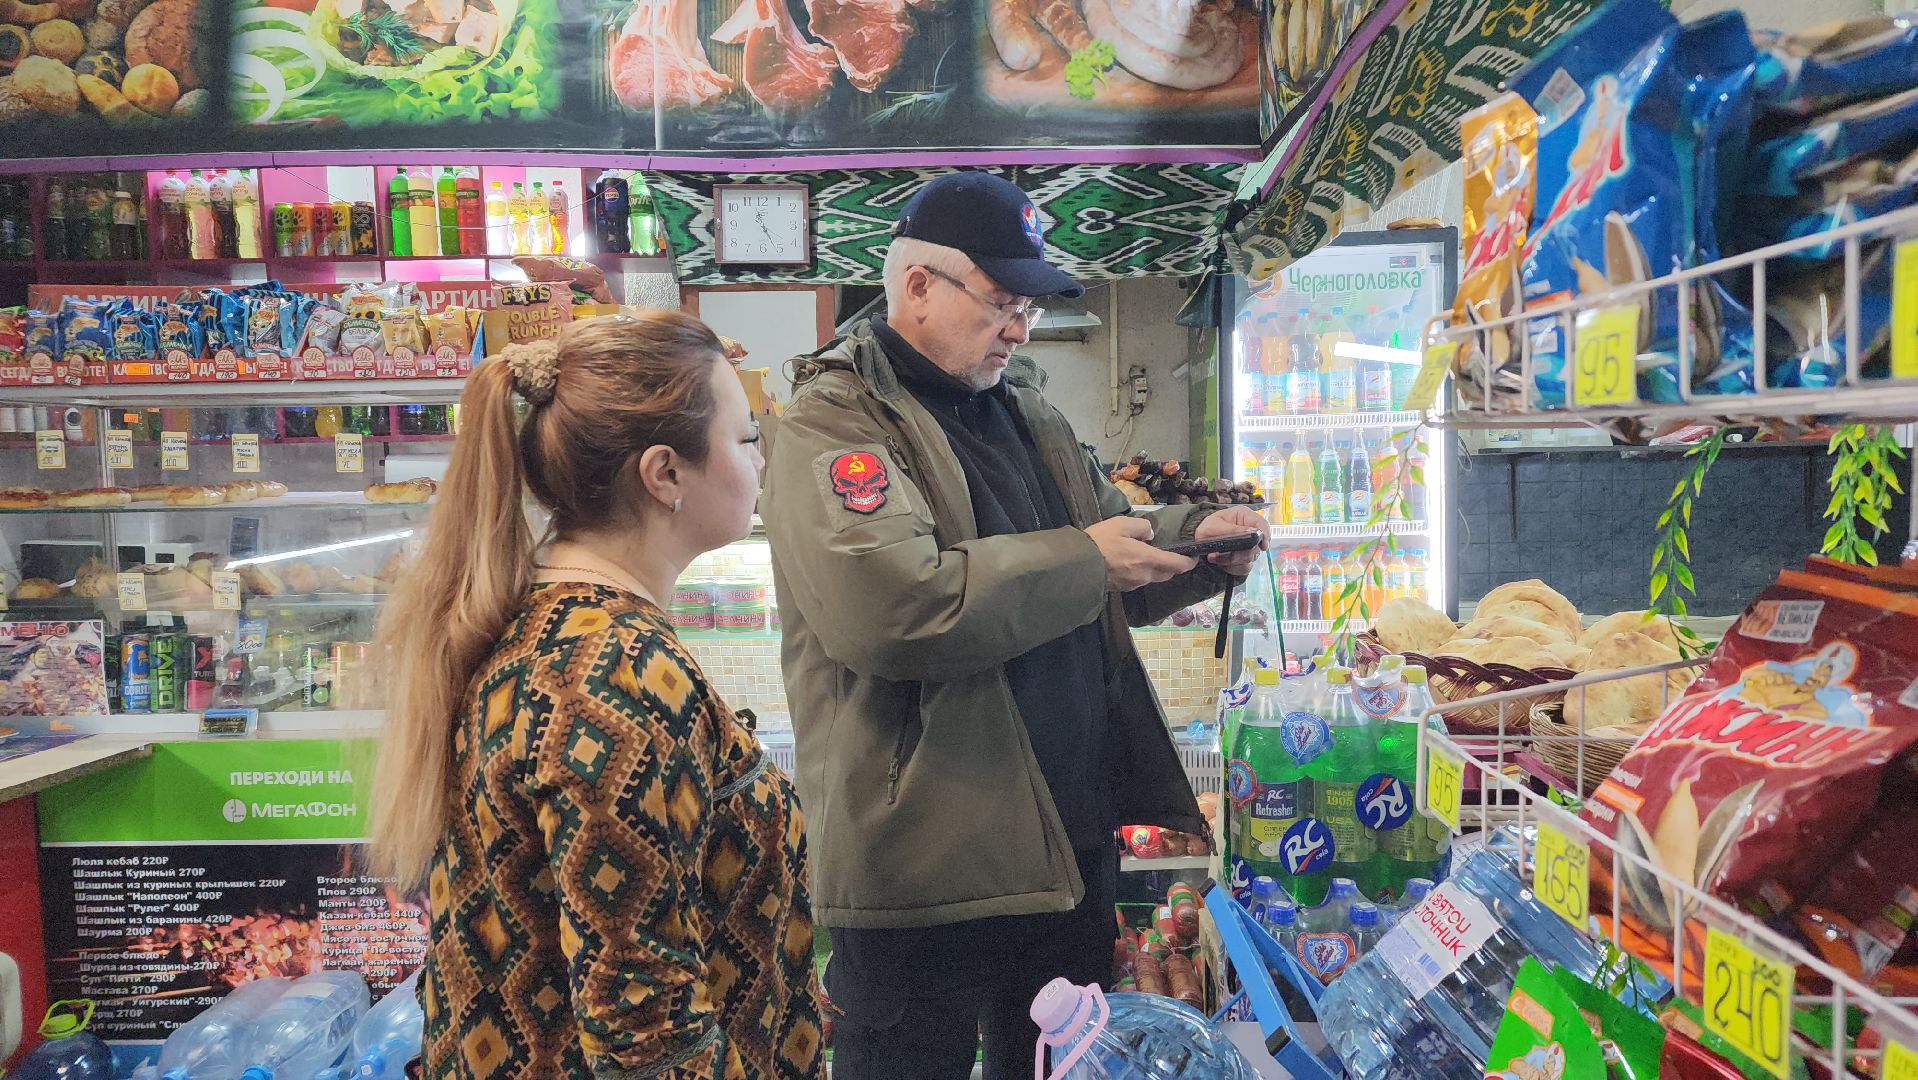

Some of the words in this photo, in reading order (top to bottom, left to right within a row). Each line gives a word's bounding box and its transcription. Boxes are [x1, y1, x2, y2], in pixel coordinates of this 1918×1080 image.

[743, 197, 752, 206] 11
[757, 196, 768, 206] 12
[776, 196, 781, 206] 1
[728, 202, 739, 212] 10
[789, 203, 797, 213] 2
[730, 220, 738, 230] 9
[789, 220, 797, 230] 3
[730, 238, 738, 248] 8
[789, 238, 797, 247] 4
[744, 243, 751, 253] 7
[759, 243, 767, 253] 6
[776, 243, 784, 253] 5
[1288, 267, 1421, 298] Черноголовка
[508, 305, 560, 324] OUBLE
[509, 324, 562, 340] RUNCH
[1580, 333, 1620, 398] 95
[157, 638, 176, 706] DRIVE
[230, 770, 324, 786] ПЕРЕХОДИ
[327, 770, 353, 784] НА
[1326, 789, 1354, 797] SINCE
[1434, 766, 1454, 814] 95
[1266, 789, 1286, 802] RC
[1326, 796, 1354, 807] 1905
[1255, 802, 1294, 816] Refresher
[1284, 818, 1325, 875] RC
[72, 857, 103, 867] Люля
[106, 856, 139, 866] кебаб
[73, 868, 122, 878] Шашлык
[125, 867, 176, 879] Куриный
[74, 880, 123, 890] Шашлык
[126, 881, 141, 889] из
[143, 881, 192, 891] куриных
[195, 879, 256, 889] крылышек
[316, 875, 357, 886] Второе
[1542, 846, 1583, 921] 165
[74, 891, 124, 901] Шашлык
[126, 891, 193, 901] "Наполеон"
[317, 886, 348, 896] Плов
[75, 903, 125, 913] Шашлык
[127, 903, 171, 914] "Рулет"
[318, 899, 356, 908] Манты
[76, 915, 126, 925] Шашлык
[128, 917, 143, 925] из
[145, 914, 202, 925] баранины
[77, 927, 123, 938] Шаурма
[321, 935, 350, 943] Мясо
[321, 945, 361, 955] Курица
[79, 951, 120, 961] Первое
[122, 951, 160, 961] блюдо
[80, 963, 117, 973] Шурпа
[80, 975, 101, 985] Суп
[1713, 960, 1783, 1065] 240
